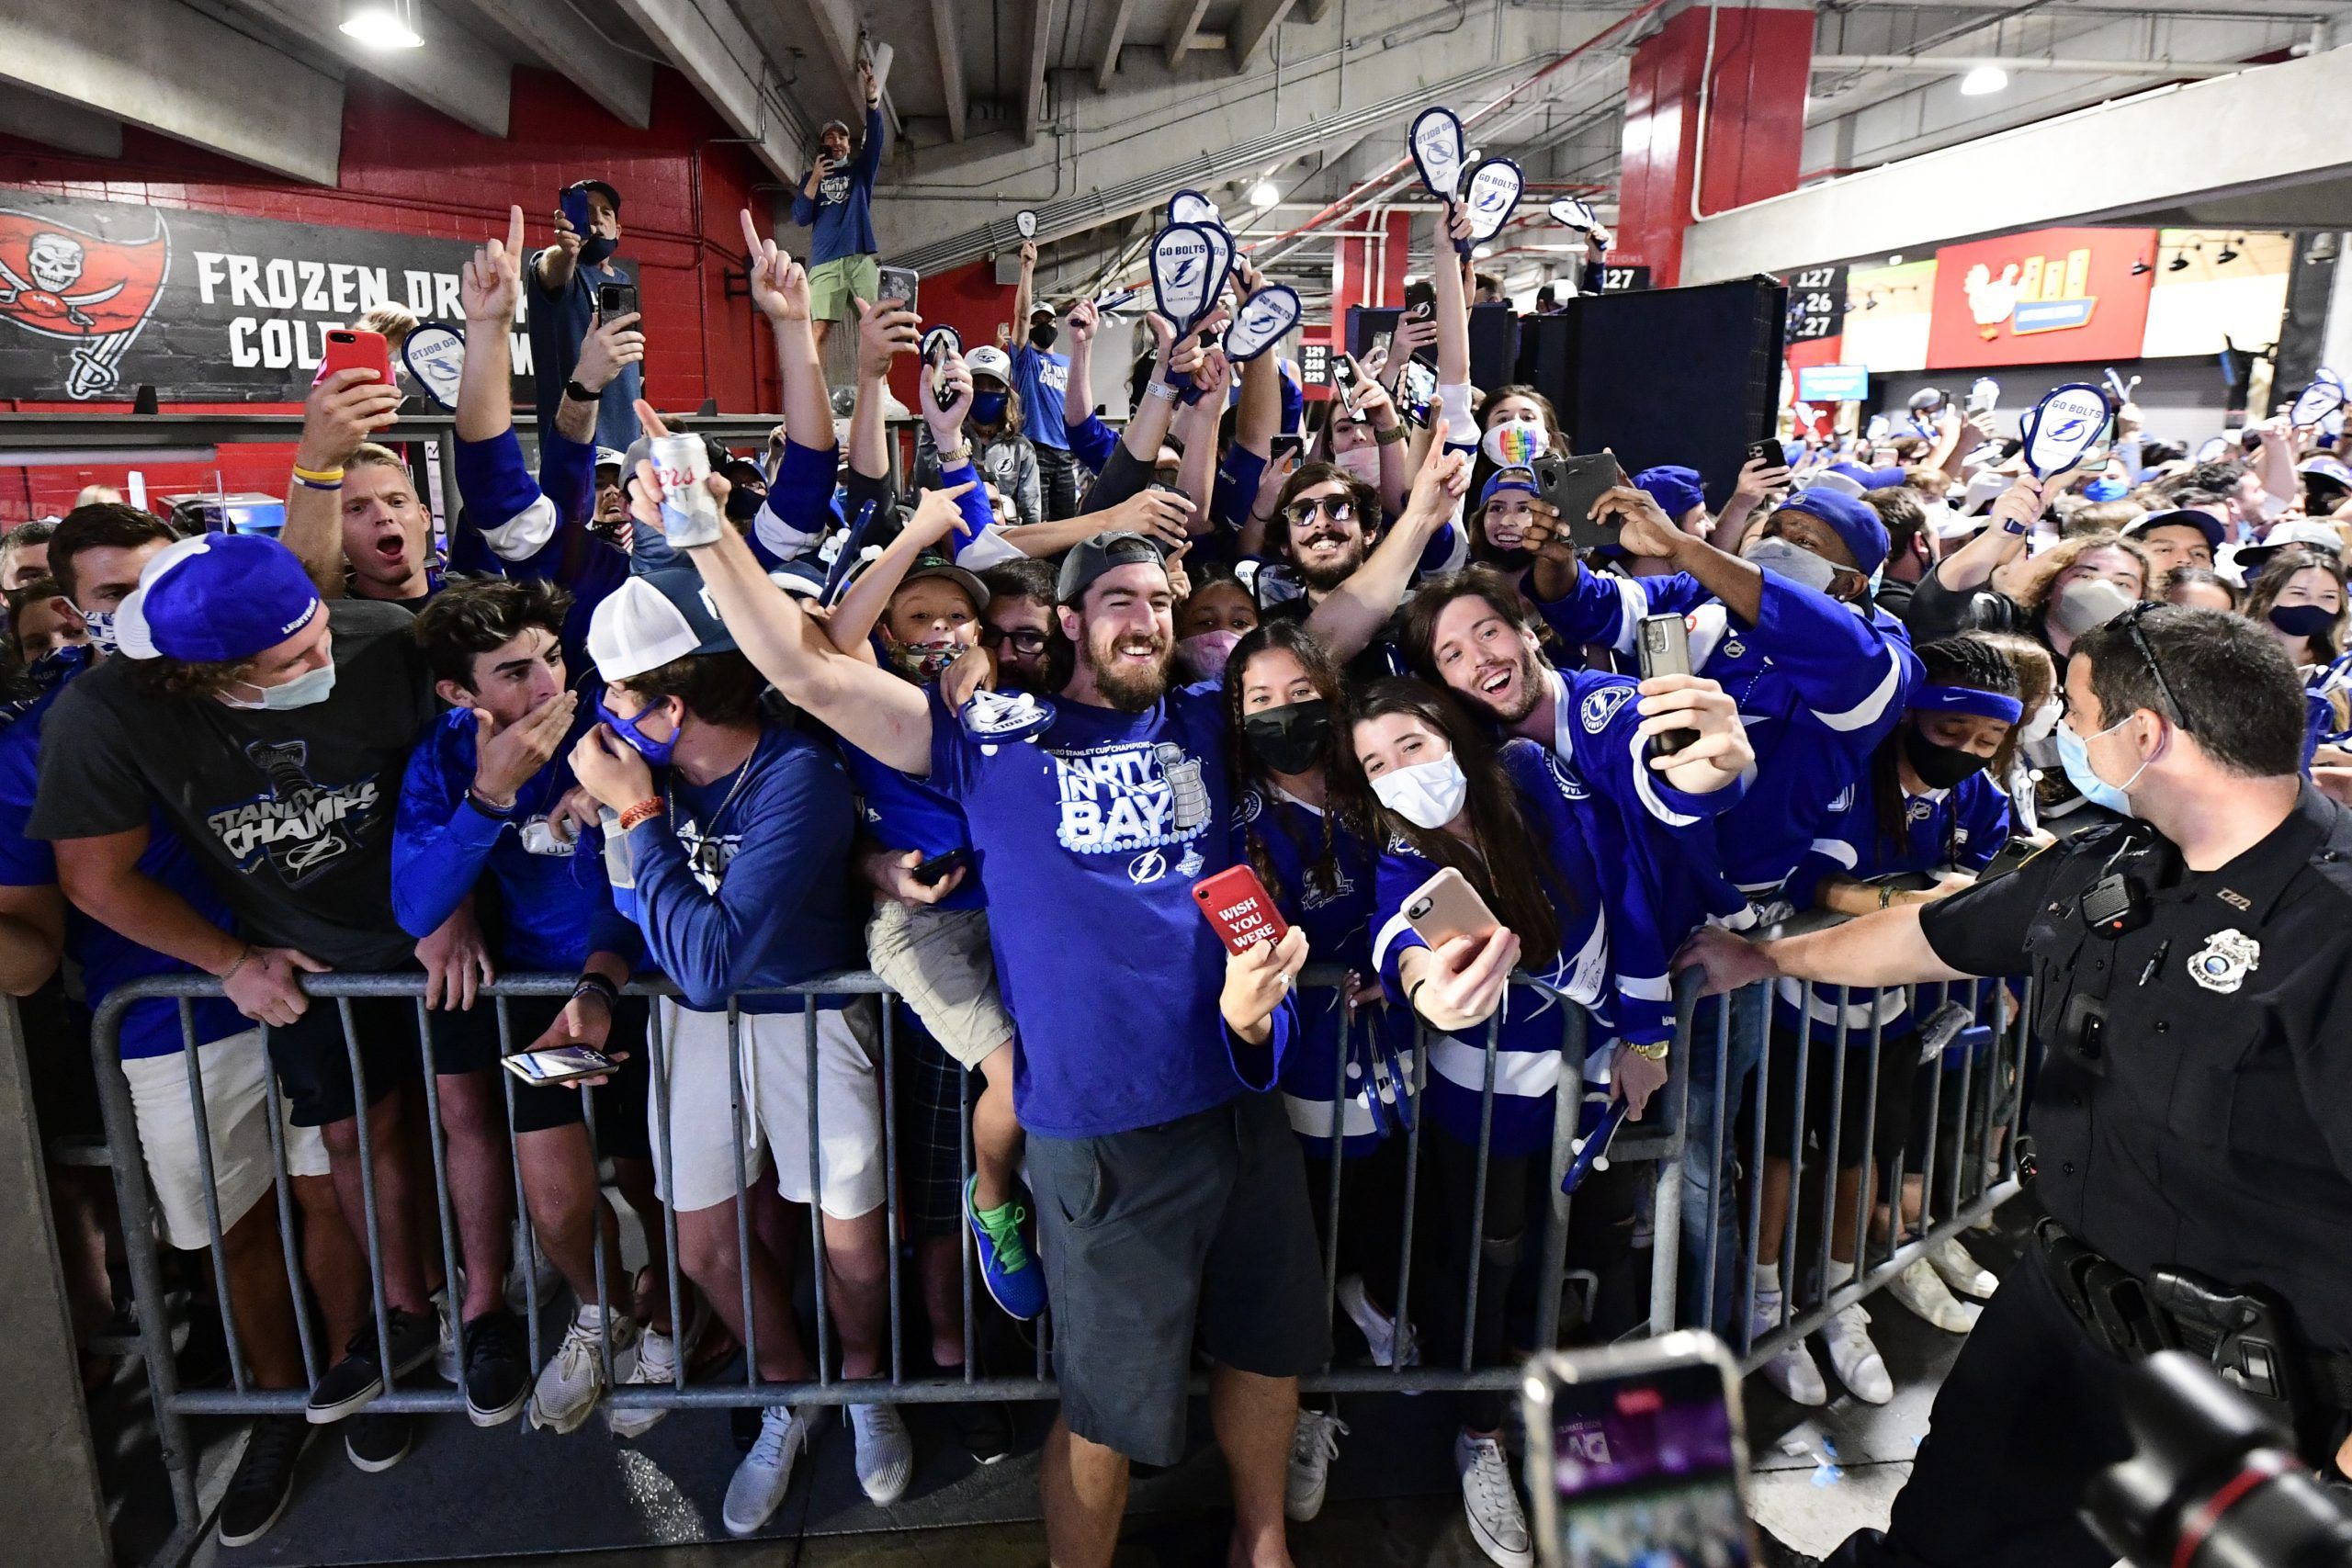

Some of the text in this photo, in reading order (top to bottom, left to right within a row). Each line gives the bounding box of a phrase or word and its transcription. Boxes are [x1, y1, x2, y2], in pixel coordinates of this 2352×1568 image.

[1478, 173, 1519, 191] GO BOLTS
[1159, 244, 1205, 256] GO BOLTS
[194, 252, 390, 313] FROZEN
[1602, 269, 1635, 288] 127
[1797, 268, 1836, 288] 127
[1806, 293, 1833, 312] 26
[229, 317, 345, 370] COL
[1305, 345, 1326, 357] 129
[1305, 371, 1326, 383] 229
[2052, 400, 2103, 418] GO BOLTS
[1066, 748, 1095, 756] STANLEY
[1110, 741, 1150, 753] CHAMPIONS
[1058, 775, 1098, 801] IN
[222, 783, 380, 859] CHAMPS
[1061, 792, 1171, 844] BAY
[1218, 897, 1259, 921] WISH
[1228, 912, 1262, 933] YOU
[1232, 923, 1276, 948] WERE
